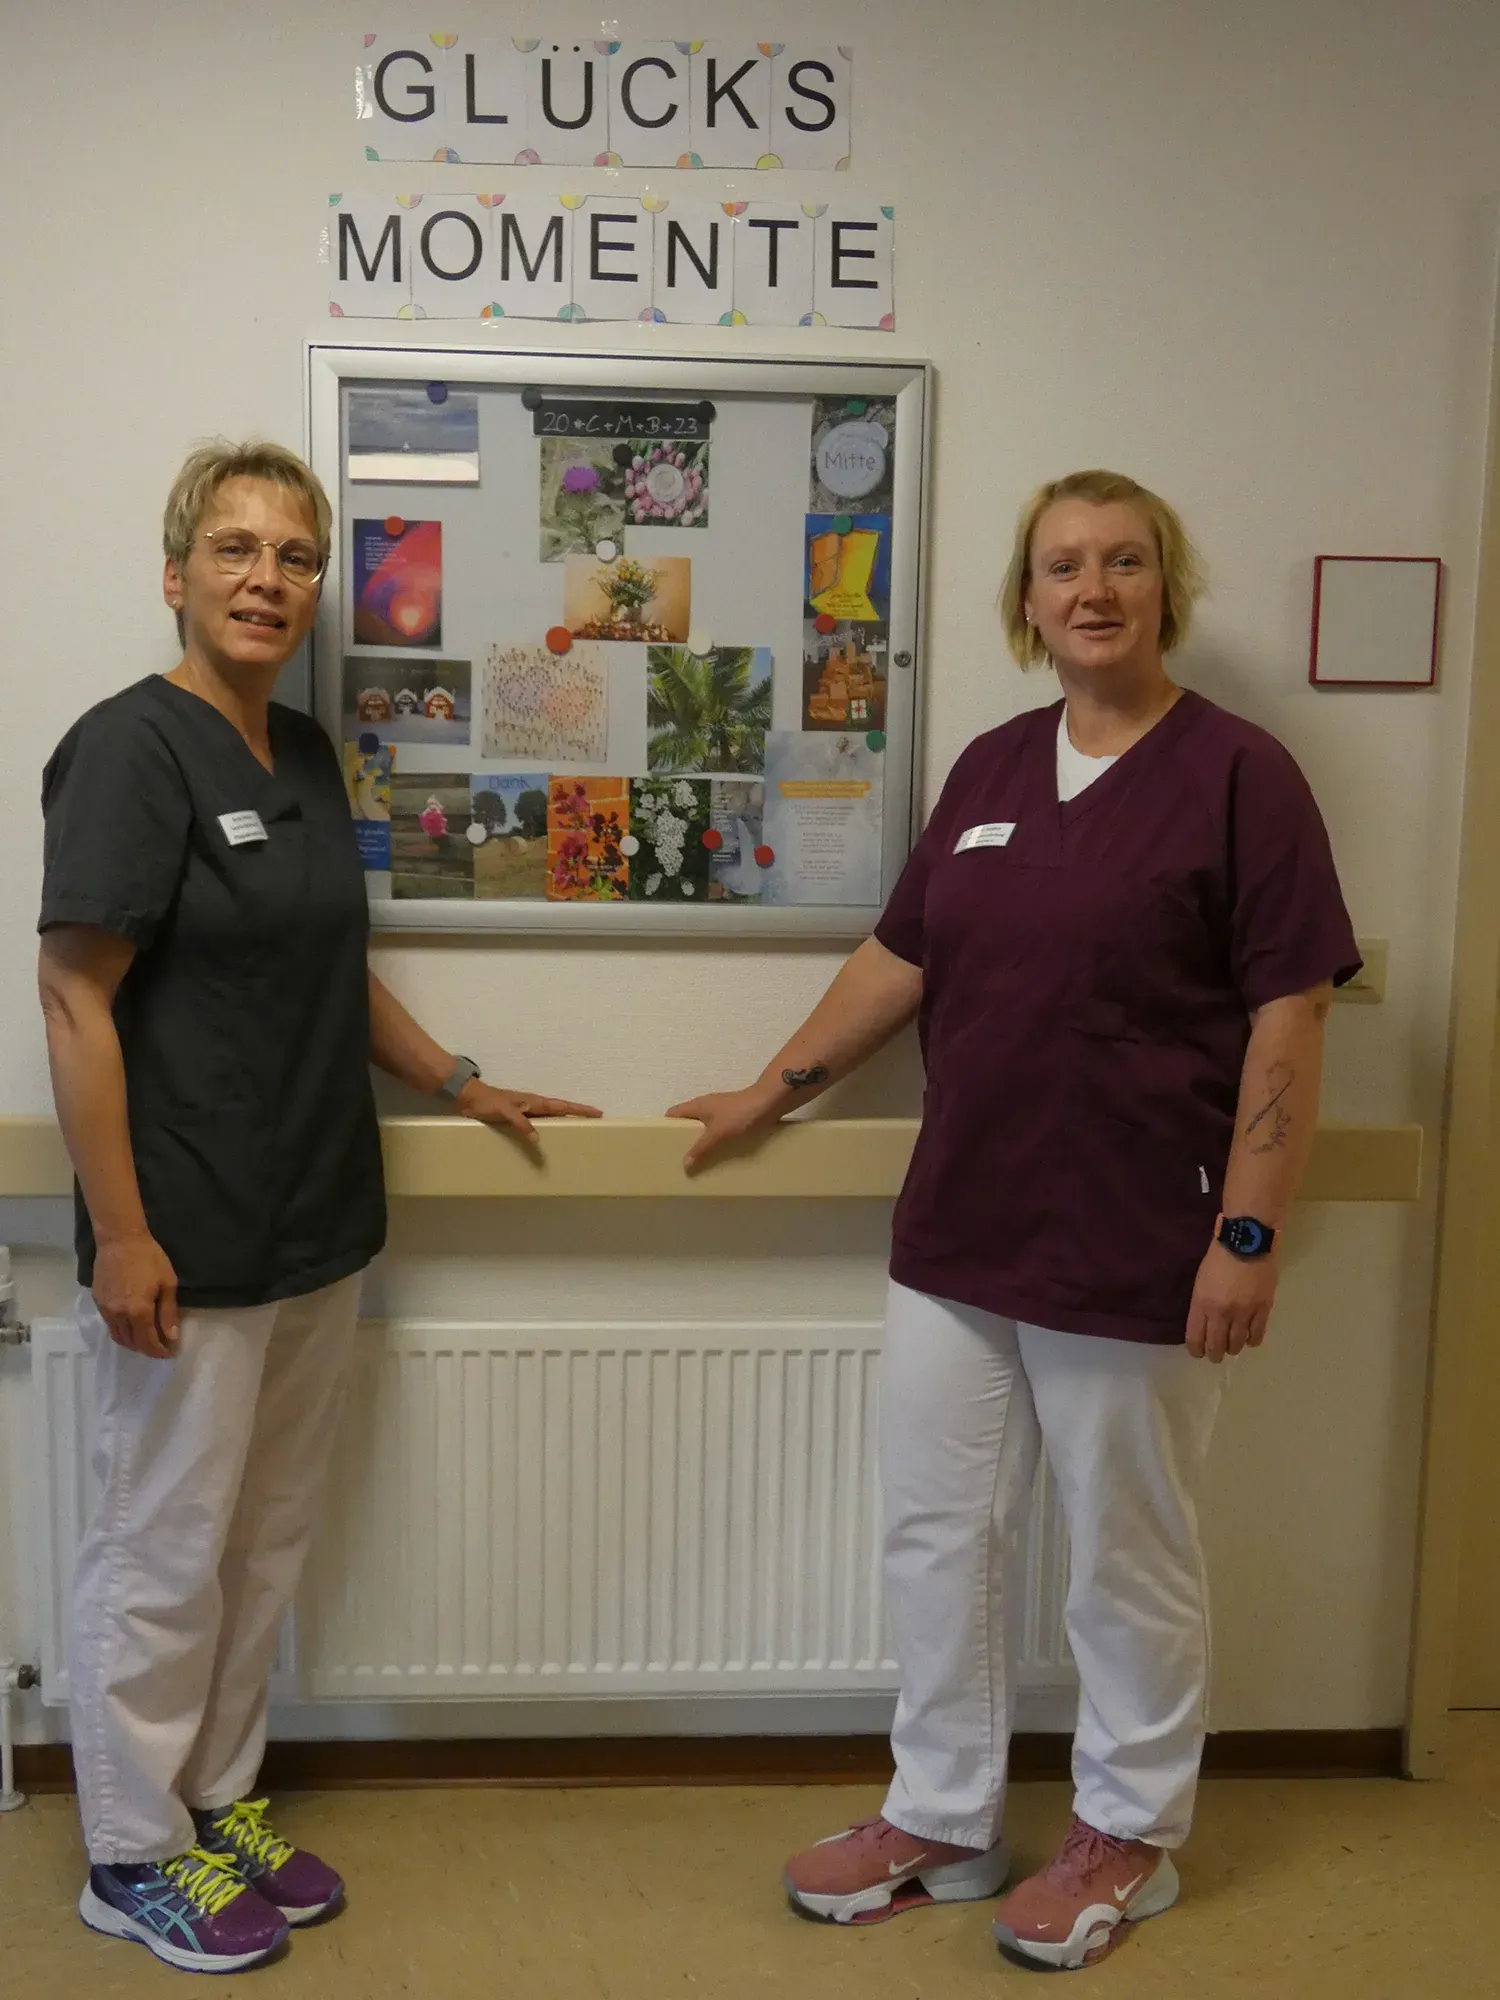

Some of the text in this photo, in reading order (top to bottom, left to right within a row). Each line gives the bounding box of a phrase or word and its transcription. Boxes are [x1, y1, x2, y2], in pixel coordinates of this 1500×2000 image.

[374, 45, 835, 132] GLÜCKS
[338, 211, 878, 289] MOMENTE
[825, 451, 876, 471] Mitte
[488, 775, 532, 790] Dank
